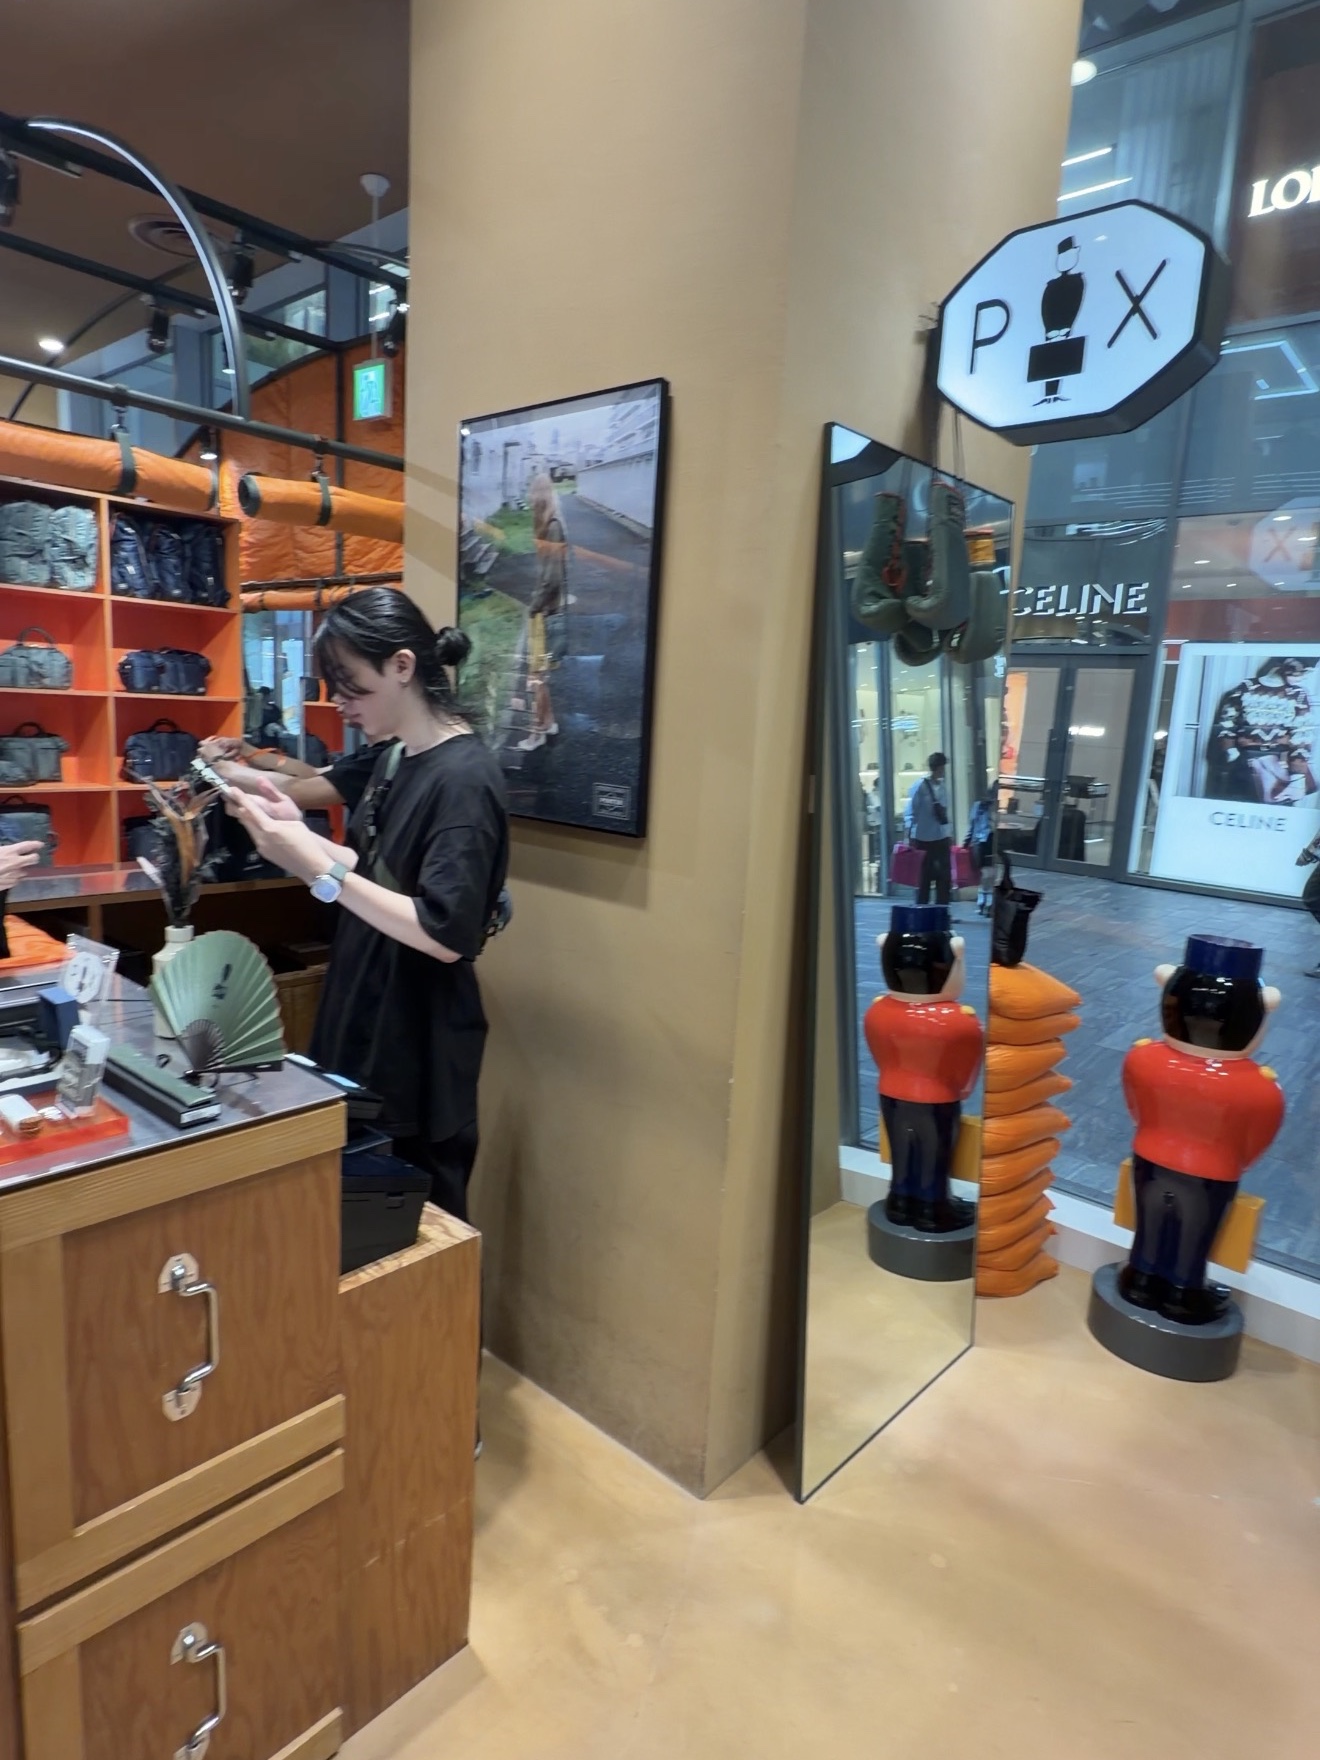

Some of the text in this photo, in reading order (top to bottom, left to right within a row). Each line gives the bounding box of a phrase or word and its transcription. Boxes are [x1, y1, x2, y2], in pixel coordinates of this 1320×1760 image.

[969, 258, 1169, 375] P X
[1011, 582, 1150, 617] CELINE
[1209, 811, 1287, 832] CELINE
